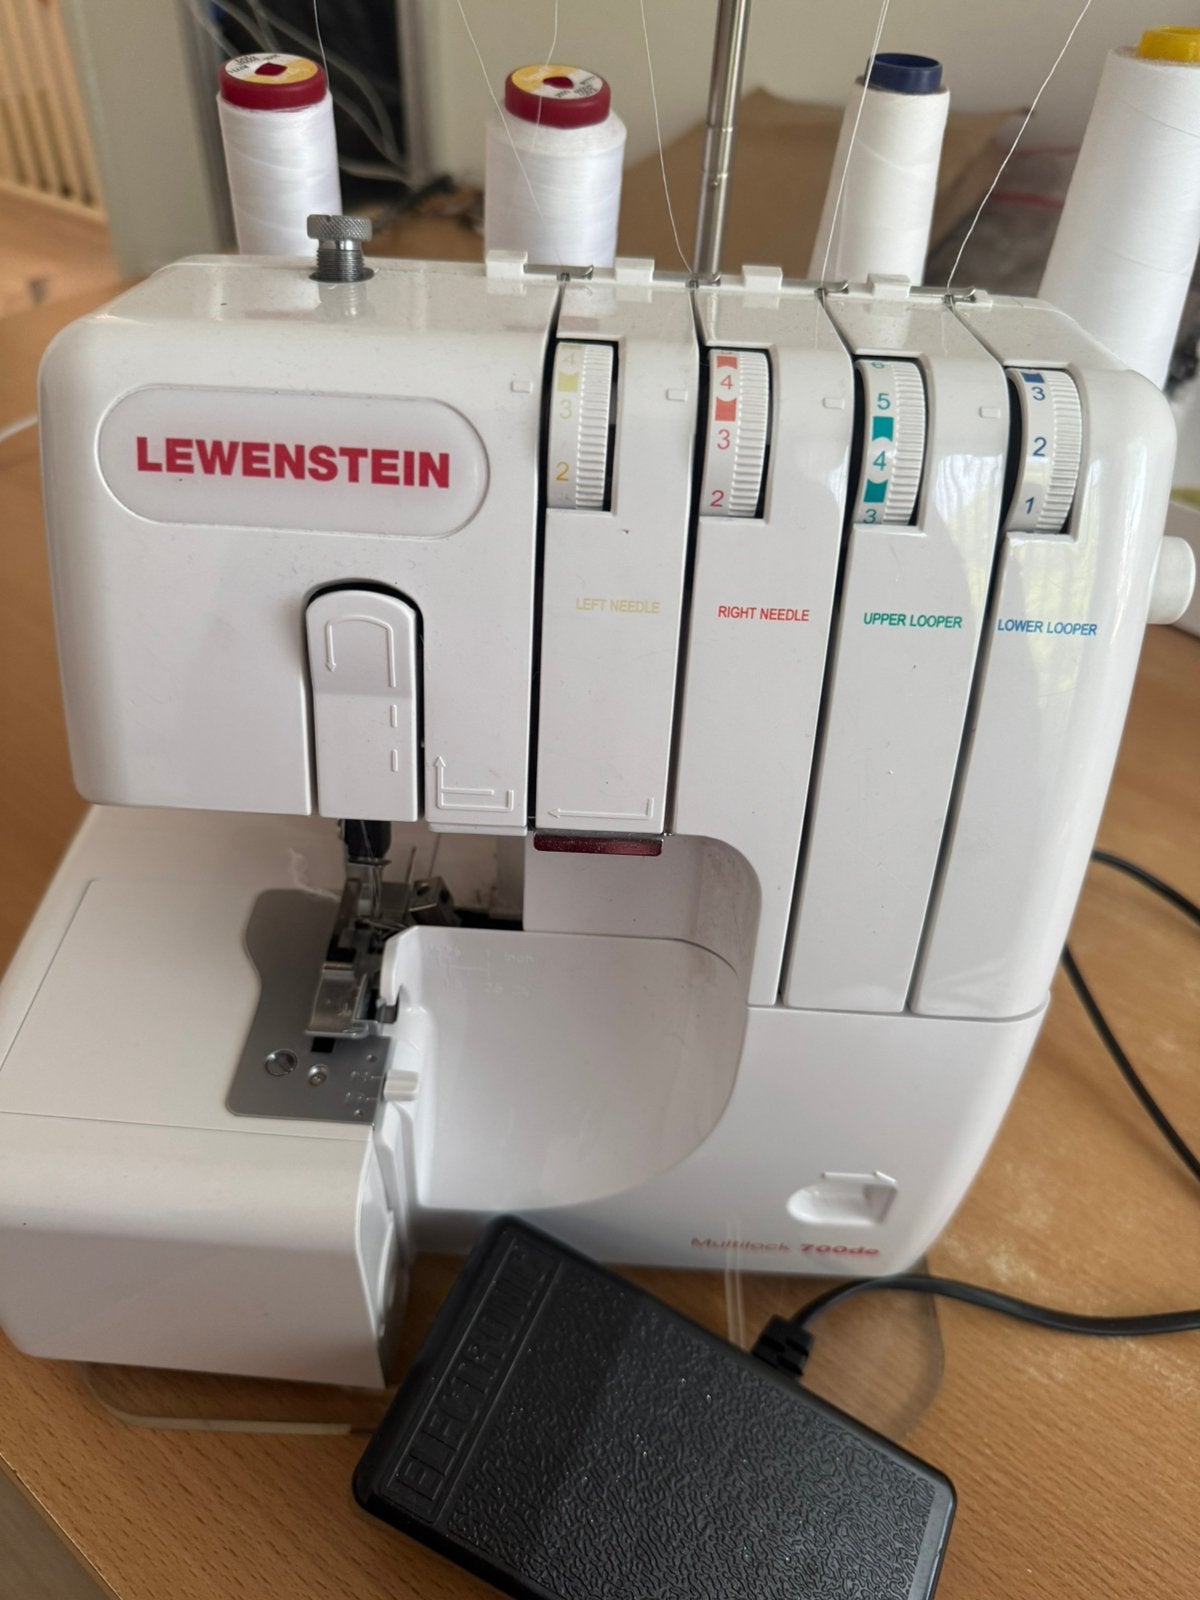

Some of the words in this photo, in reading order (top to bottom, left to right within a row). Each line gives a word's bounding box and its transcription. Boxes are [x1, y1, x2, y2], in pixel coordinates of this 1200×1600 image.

[720, 374, 733, 390] 4
[877, 393, 891, 410] 5
[1031, 386, 1046, 401] 3
[559, 400, 572, 419] 3
[717, 429, 730, 450] 3
[1032, 436, 1047, 457] 2
[136, 436, 450, 489] LEWENSTEIN
[872, 450, 887, 471] 4
[555, 461, 570, 481] 2
[710, 489, 724, 507] 2
[1025, 497, 1035, 514] 1
[863, 509, 877, 524] 3
[575, 597, 607, 611] LEFT
[609, 599, 661, 614] NEEDLE
[717, 605, 756, 620] RIGHT
[759, 607, 810, 622] NEEDLE
[863, 612, 905, 626] UPPER
[909, 614, 963, 629] LOOPER
[997, 618, 1043, 633] LOWER
[1046, 621, 1098, 636] LOOPER
